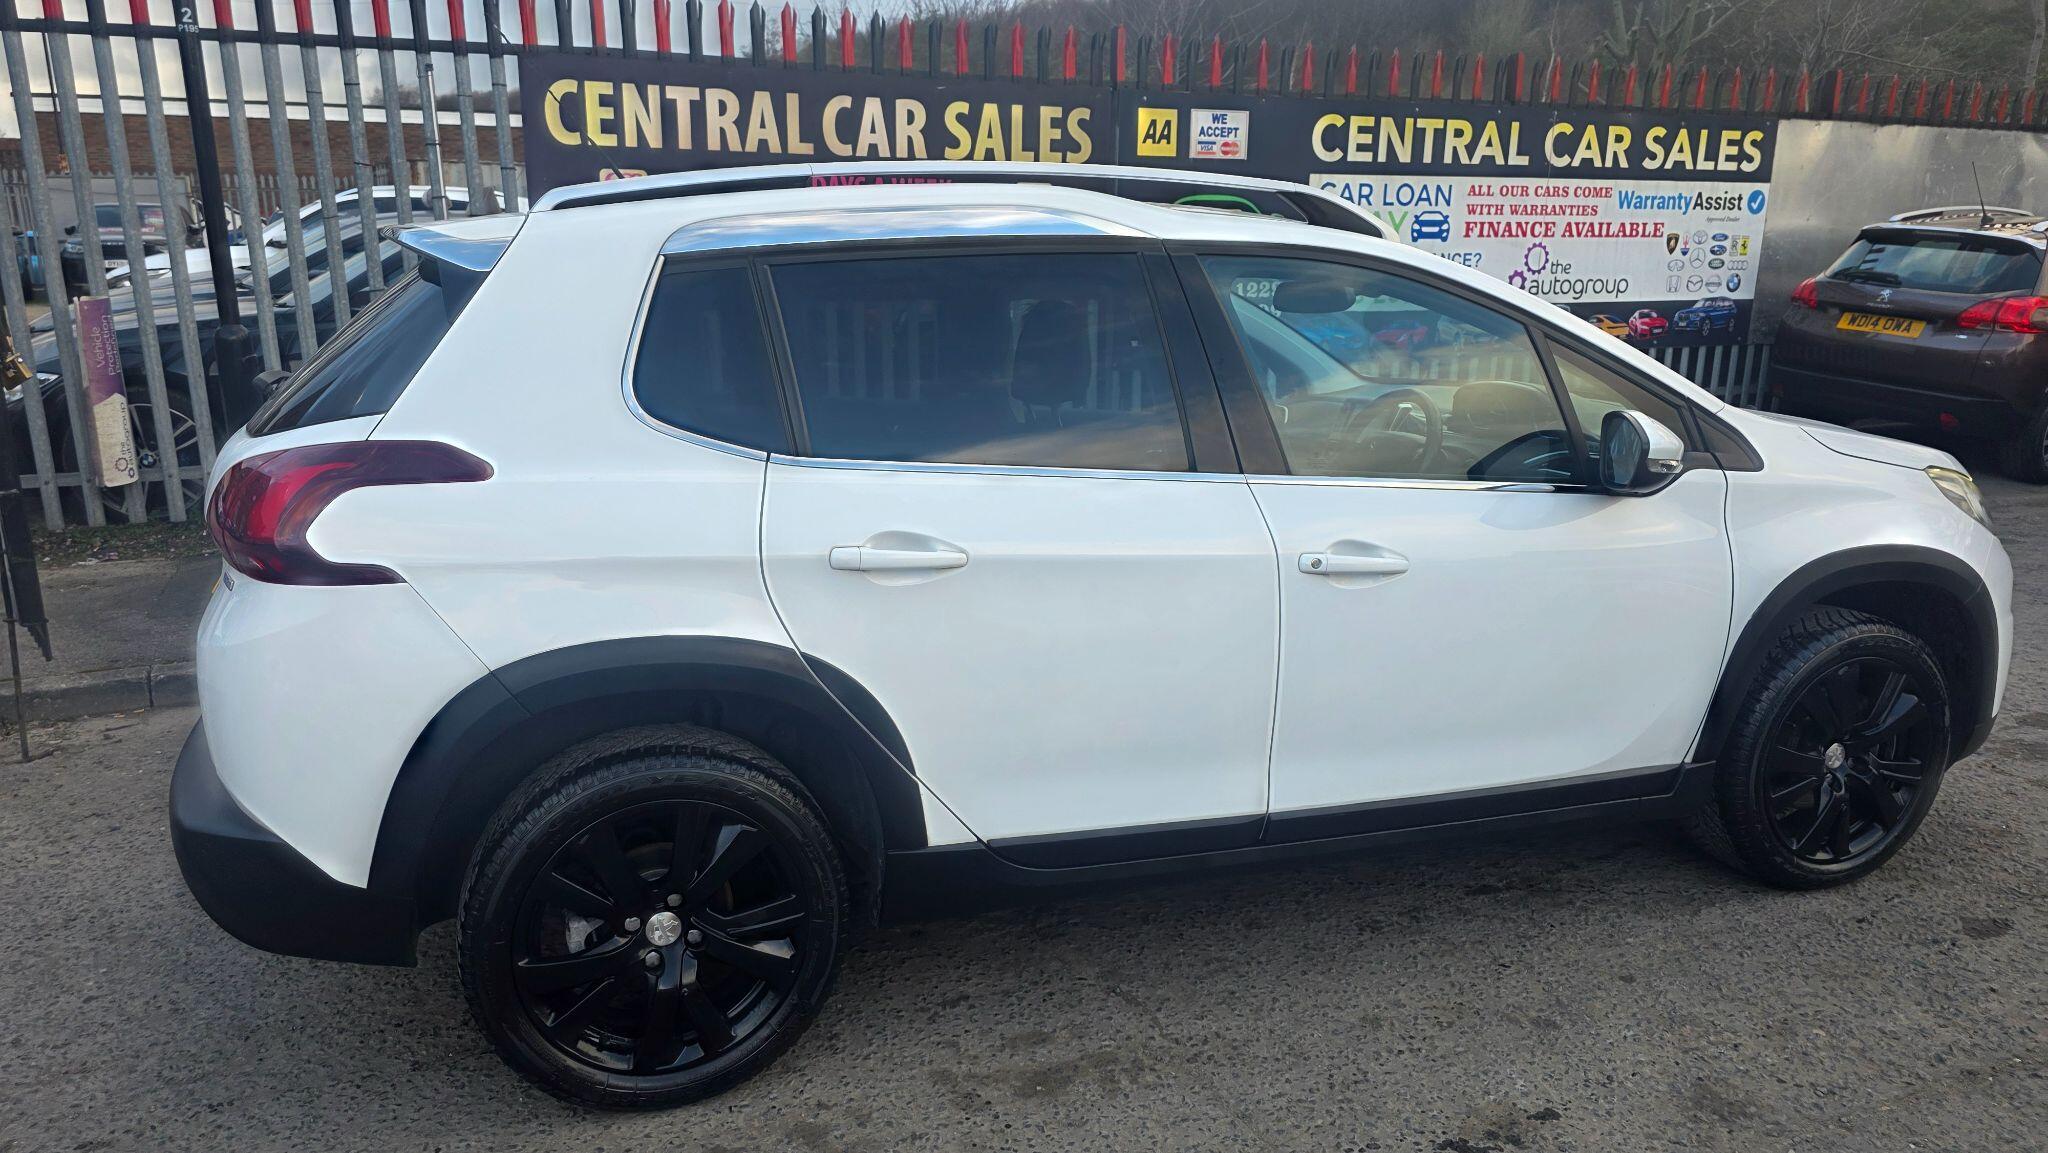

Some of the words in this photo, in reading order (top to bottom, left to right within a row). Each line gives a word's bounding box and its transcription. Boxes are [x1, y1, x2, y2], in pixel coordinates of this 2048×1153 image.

[181, 7, 193, 23] 2
[545, 79, 815, 155] CENTRAL
[822, 95, 927, 159] CAR
[944, 101, 1092, 164] SALES
[1211, 113, 1228, 125] WE
[1142, 119, 1172, 145] AA
[1198, 126, 1240, 138] ACCEPT
[1311, 113, 1529, 166] CENTRAL
[1545, 123, 1632, 169] CAR
[1642, 126, 1764, 172] SALES
[1382, 183, 1453, 208] LOAN
[1467, 185, 1495, 197] ALL
[1500, 185, 1530, 198] OUR
[1534, 186, 1570, 199] CARS
[1573, 186, 1613, 199] COME
[1466, 204, 1504, 216] WITH
[1509, 204, 1599, 217] WARRANTIES
[1462, 221, 1556, 238] FINANCE
[1560, 221, 1665, 239] AVAILABLE
[1550, 259, 1571, 275] the
[1528, 276, 1629, 300] autogroup
[1847, 313, 1881, 329] WD14
[1882, 318, 1913, 333] OWA
[91, 326, 105, 368] Vehicle
[101, 314, 116, 376] Protection
